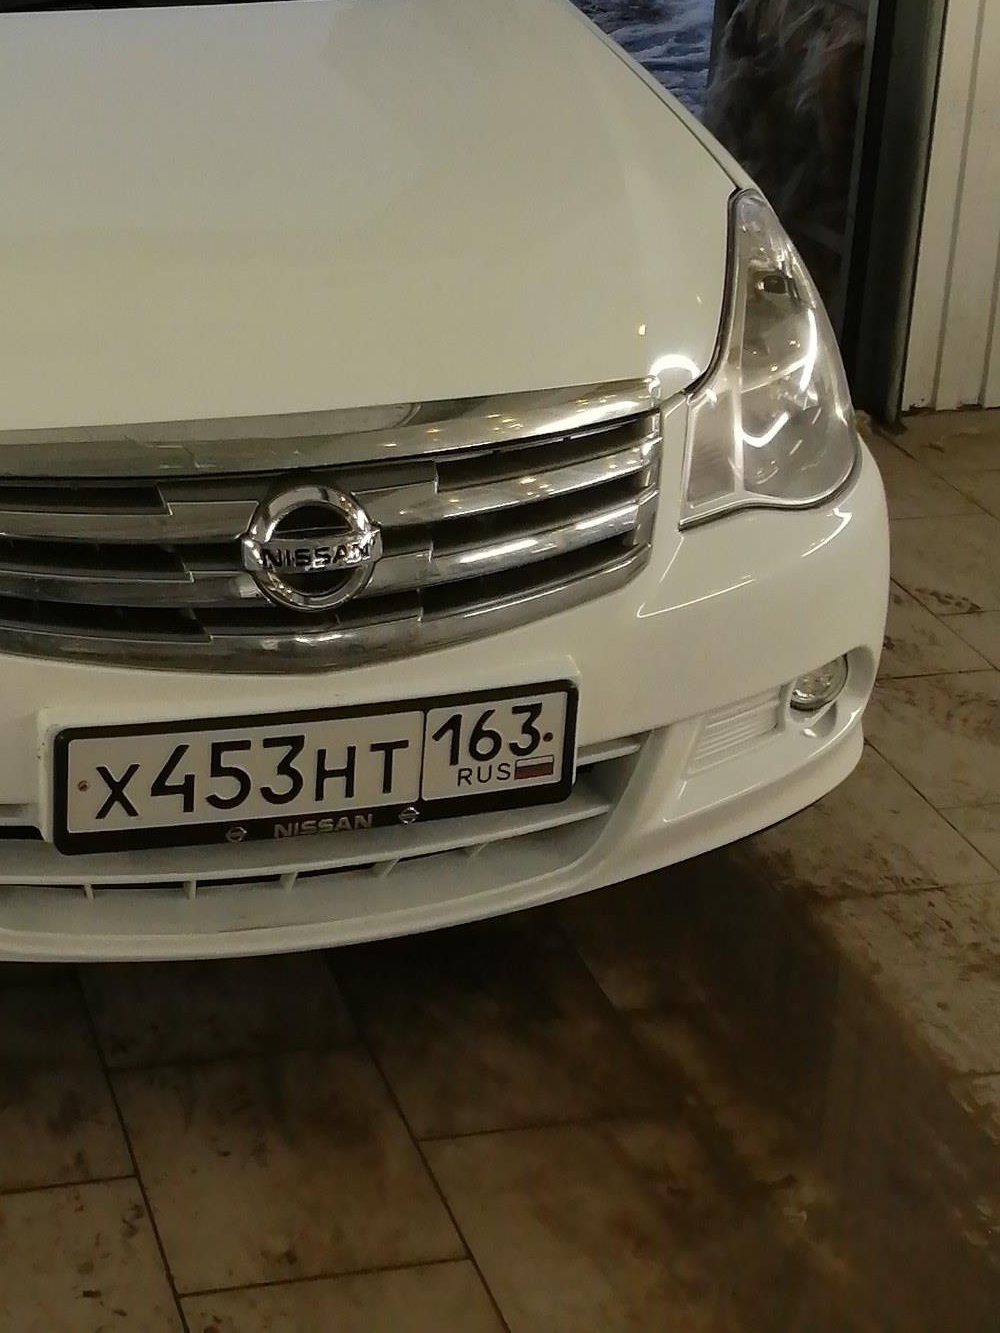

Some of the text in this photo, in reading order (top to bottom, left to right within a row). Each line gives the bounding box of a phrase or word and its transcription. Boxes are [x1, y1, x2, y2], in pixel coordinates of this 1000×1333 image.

[262, 543, 370, 568] NISSAN
[431, 703, 543, 765] 163
[458, 762, 511, 786] RUS
[274, 813, 373, 839] NISSAN
